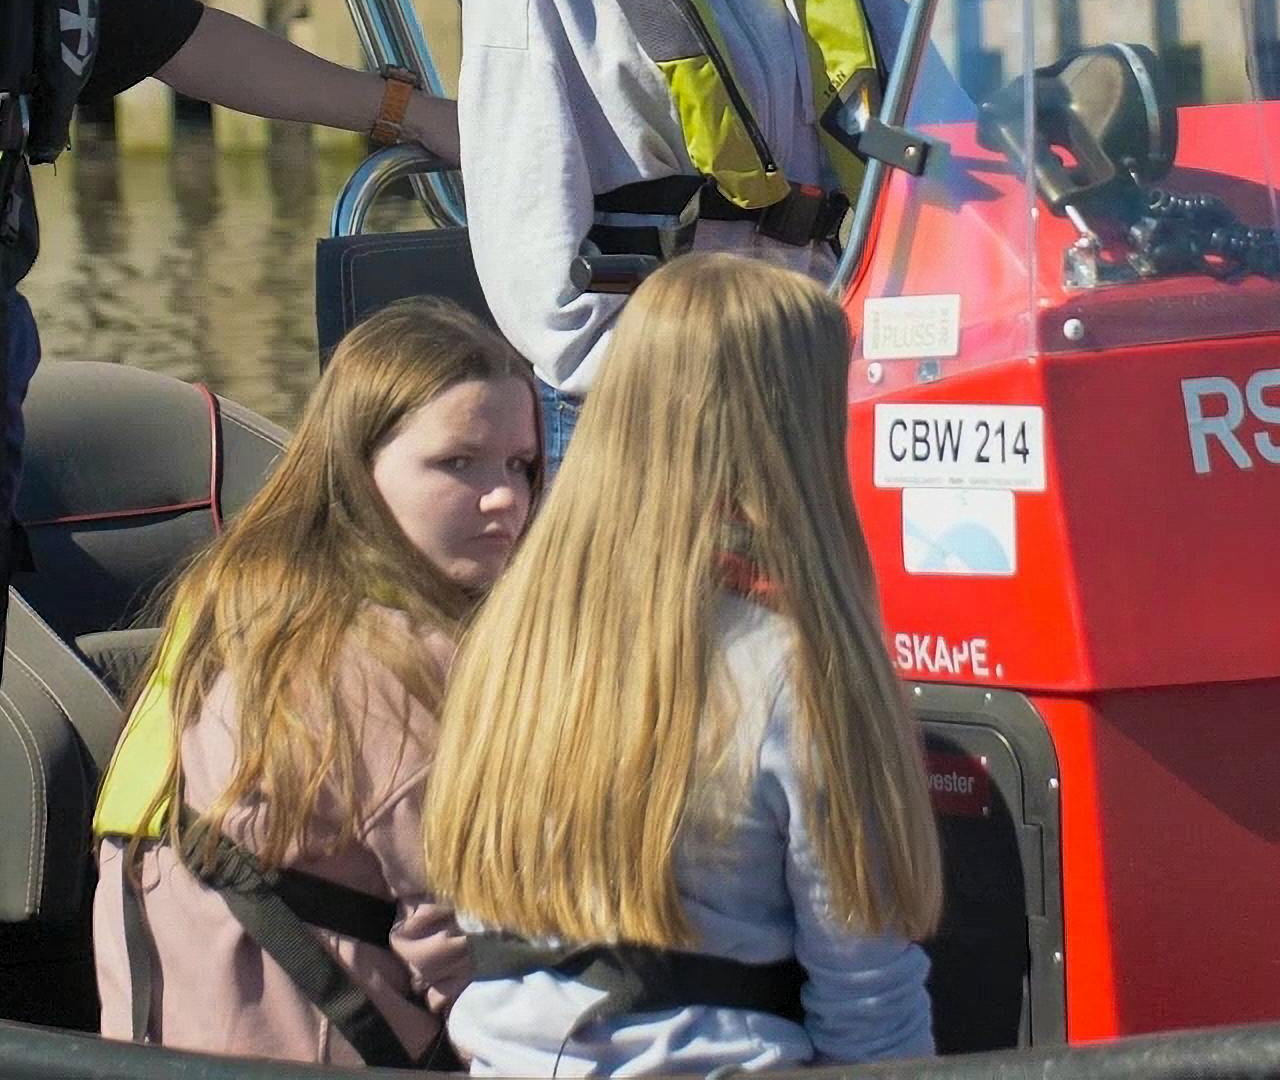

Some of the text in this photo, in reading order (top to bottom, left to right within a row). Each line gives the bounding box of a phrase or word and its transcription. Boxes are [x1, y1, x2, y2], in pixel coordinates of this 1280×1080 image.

[888, 418, 1030, 464] CBW 214
[927, 770, 975, 794] vester
